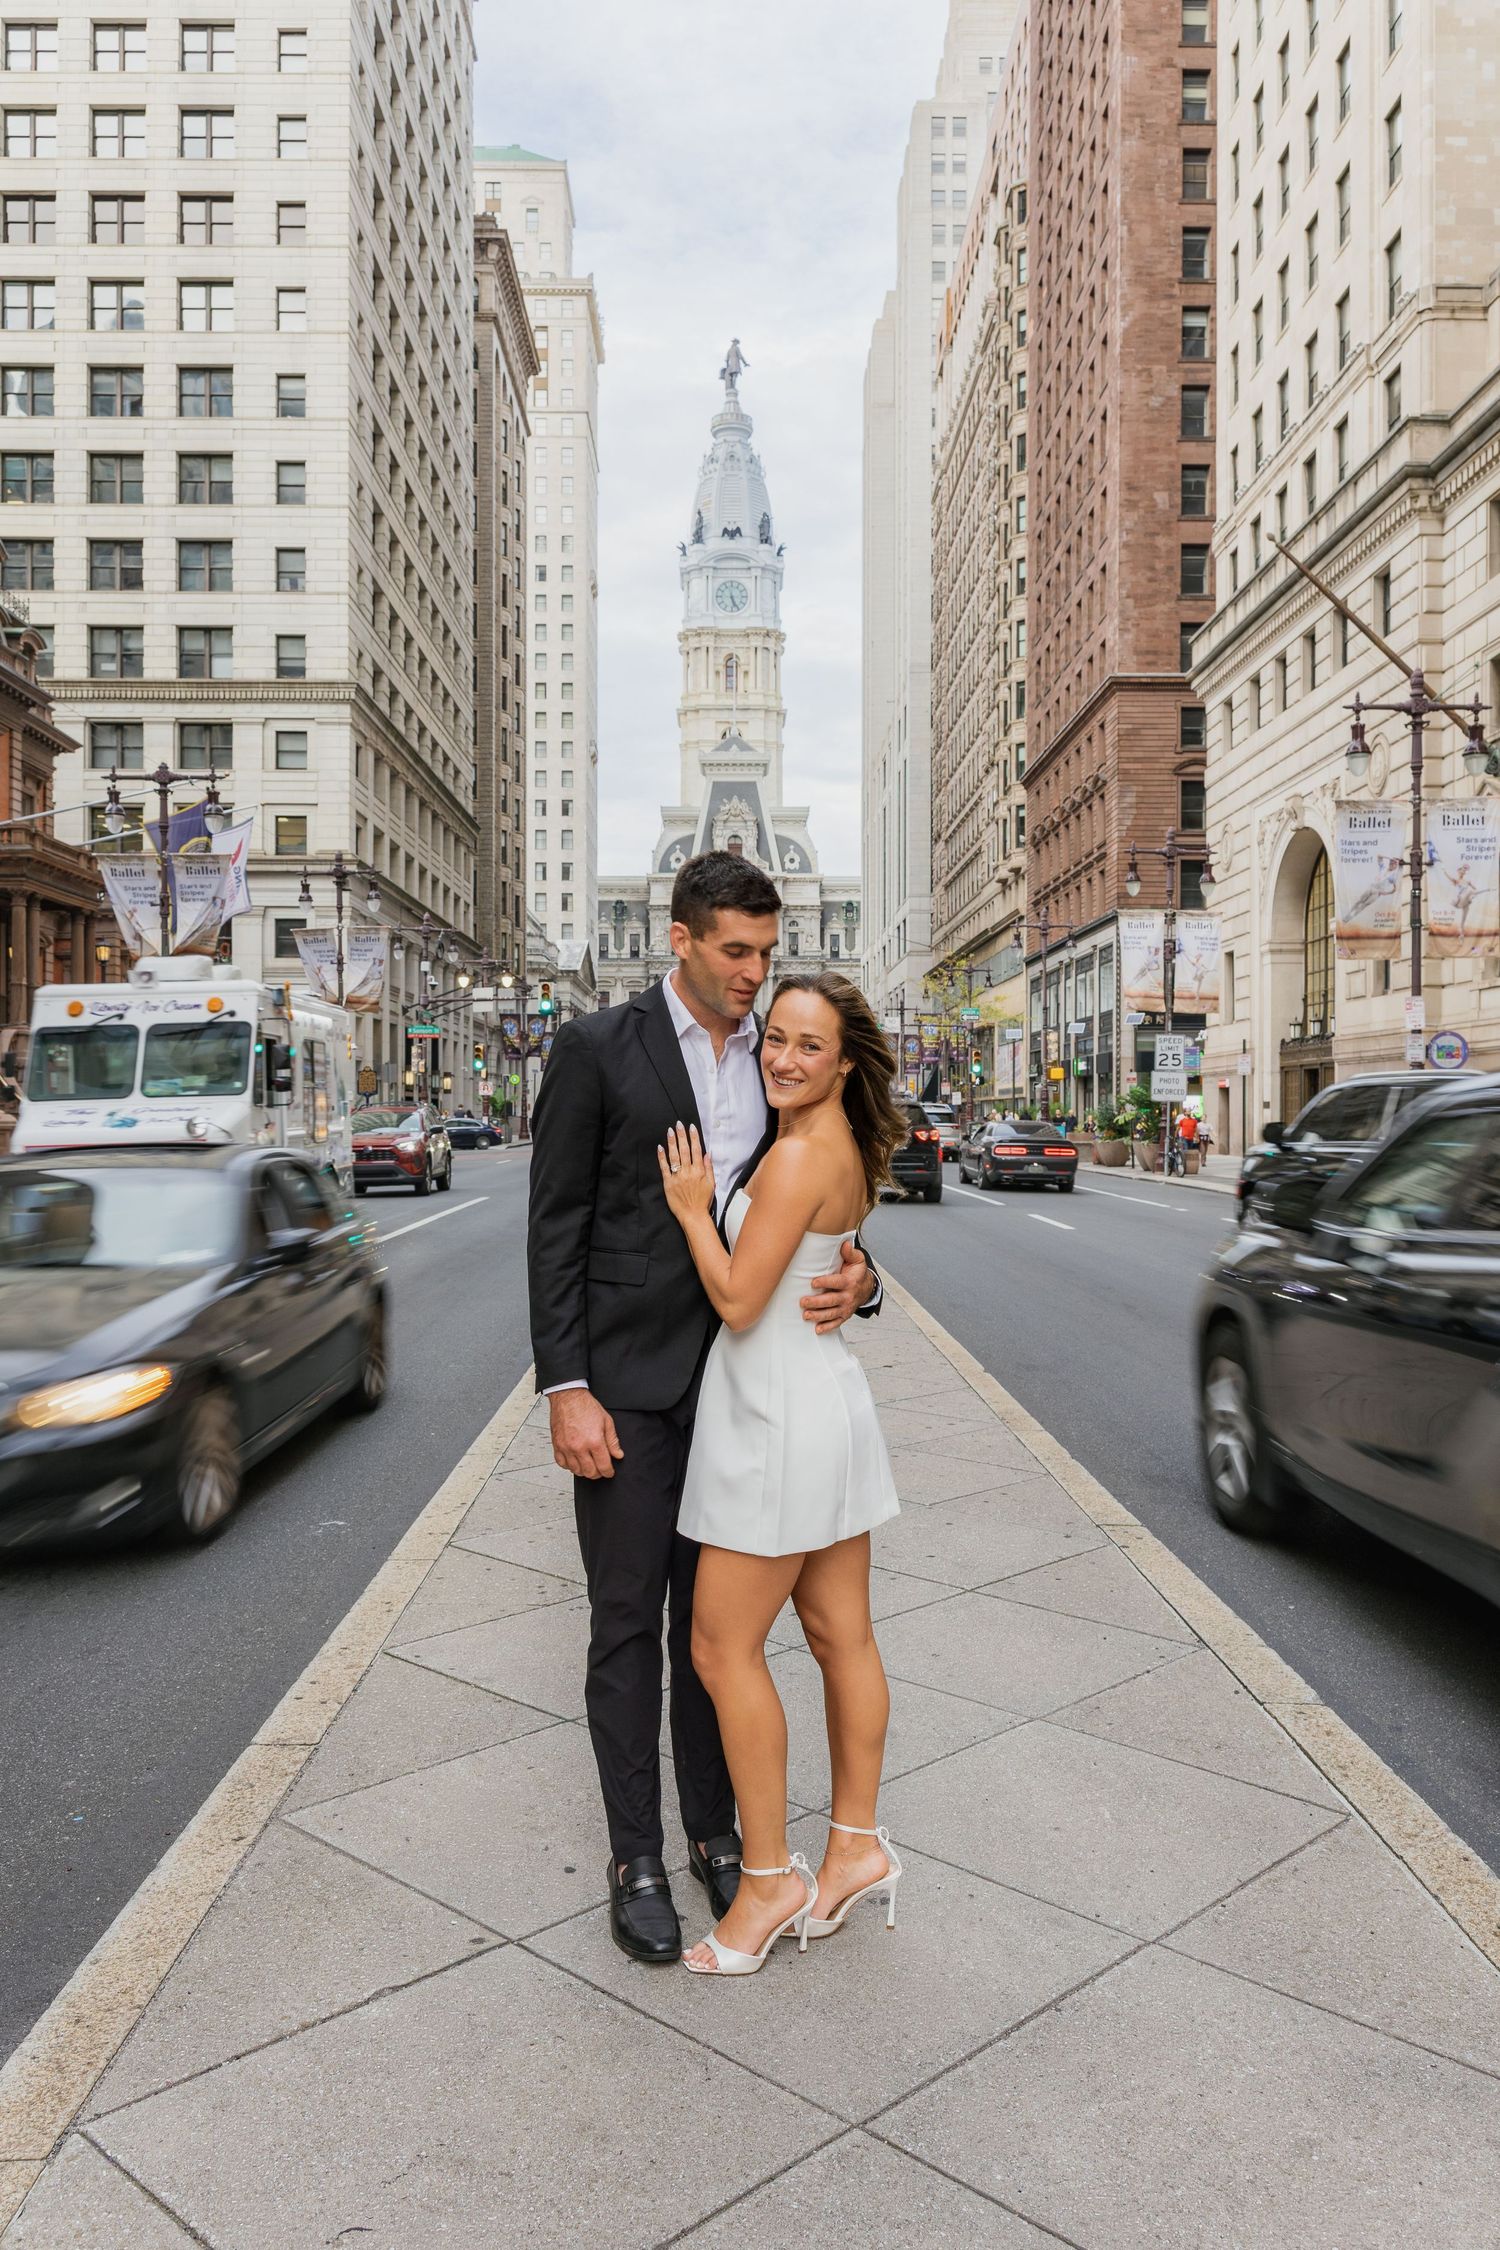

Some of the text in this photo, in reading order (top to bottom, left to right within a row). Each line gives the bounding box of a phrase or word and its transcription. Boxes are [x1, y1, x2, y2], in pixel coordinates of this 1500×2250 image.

[1349, 816, 1391, 829] Ballet
[1442, 814, 1485, 826] Ballet
[1340, 848, 1368, 856] Stripes
[1466, 845, 1496, 853] Stripes
[110, 867, 145, 877] Ballet
[185, 865, 221, 875] Ballet
[1127, 921, 1155, 929] Ballet
[1185, 922, 1213, 930] Ballet
[302, 937, 328, 945] Ballet
[1158, 1053, 1182, 1067] 25
